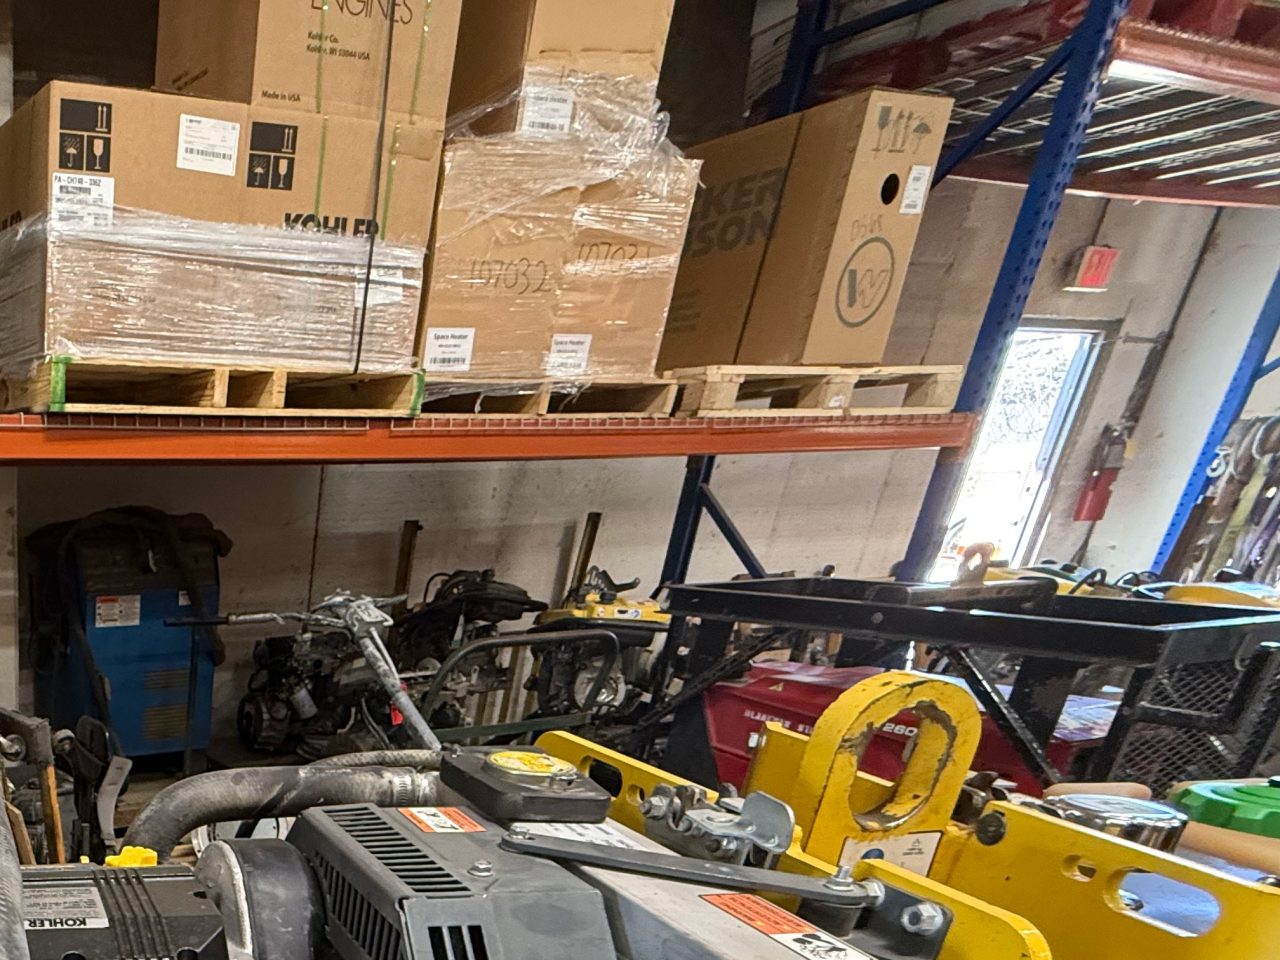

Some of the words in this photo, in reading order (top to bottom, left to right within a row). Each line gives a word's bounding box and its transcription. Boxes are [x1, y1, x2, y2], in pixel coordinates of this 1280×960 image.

[696, 167, 788, 216] KER
[689, 210, 773, 258] SON
[882, 722, 919, 737] 260
[29, 917, 87, 928] KOHLER
